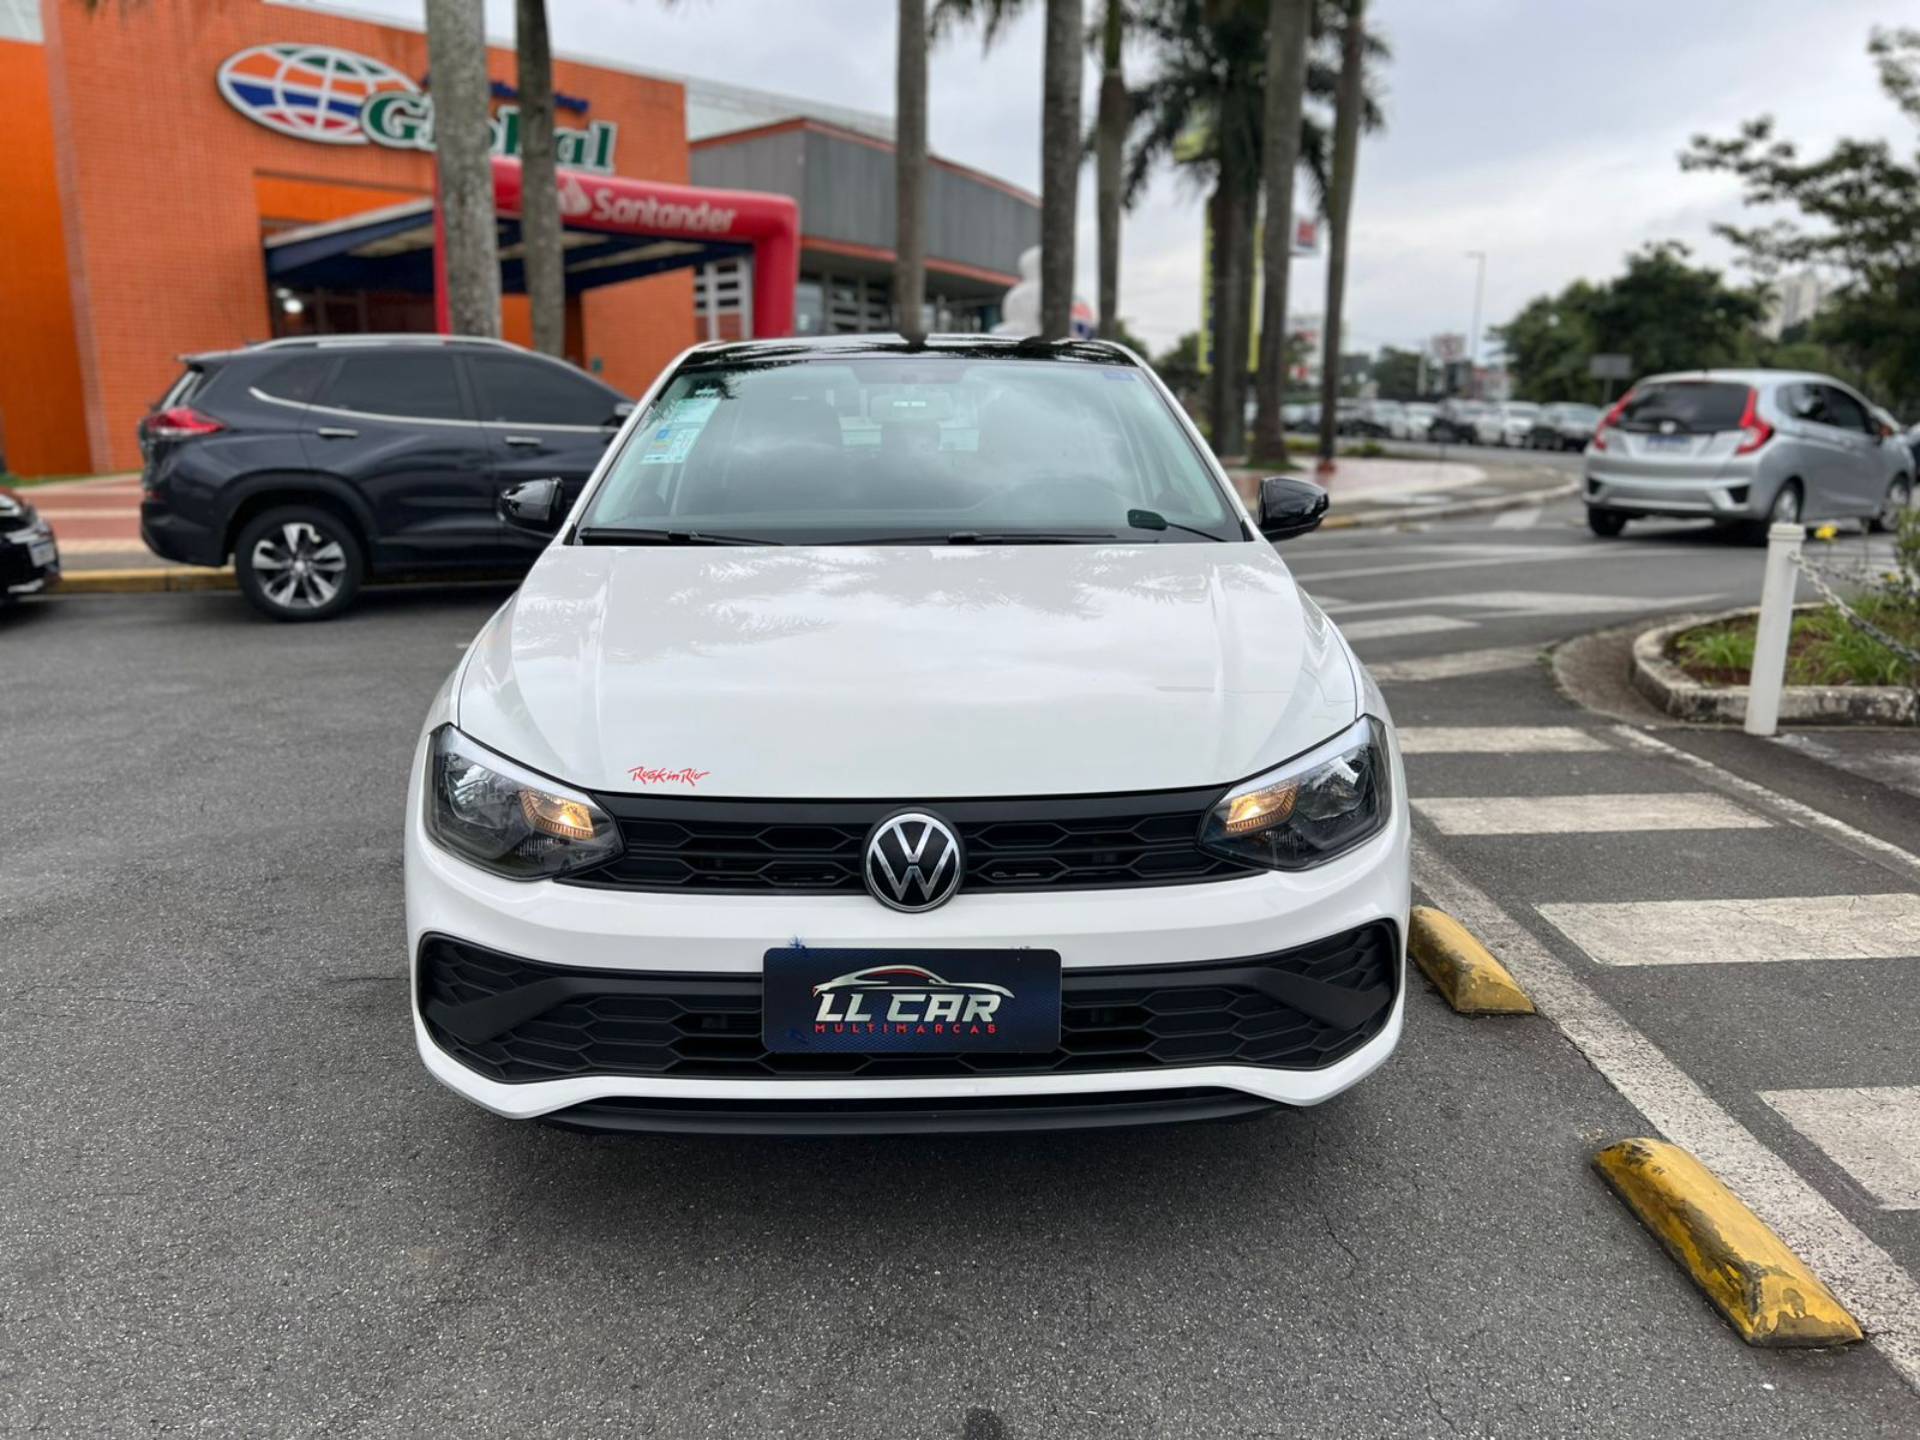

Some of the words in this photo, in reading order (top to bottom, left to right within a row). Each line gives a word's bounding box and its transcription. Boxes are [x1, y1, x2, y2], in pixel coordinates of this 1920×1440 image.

[363, 91, 616, 174] Gal
[592, 187, 736, 232] Santander
[627, 766, 666, 784] Rock
[680, 768, 710, 786] Rio
[815, 993, 872, 1022] LL
[886, 993, 1001, 1022] CAR
[815, 1024, 998, 1034] MULTIMARCAS
